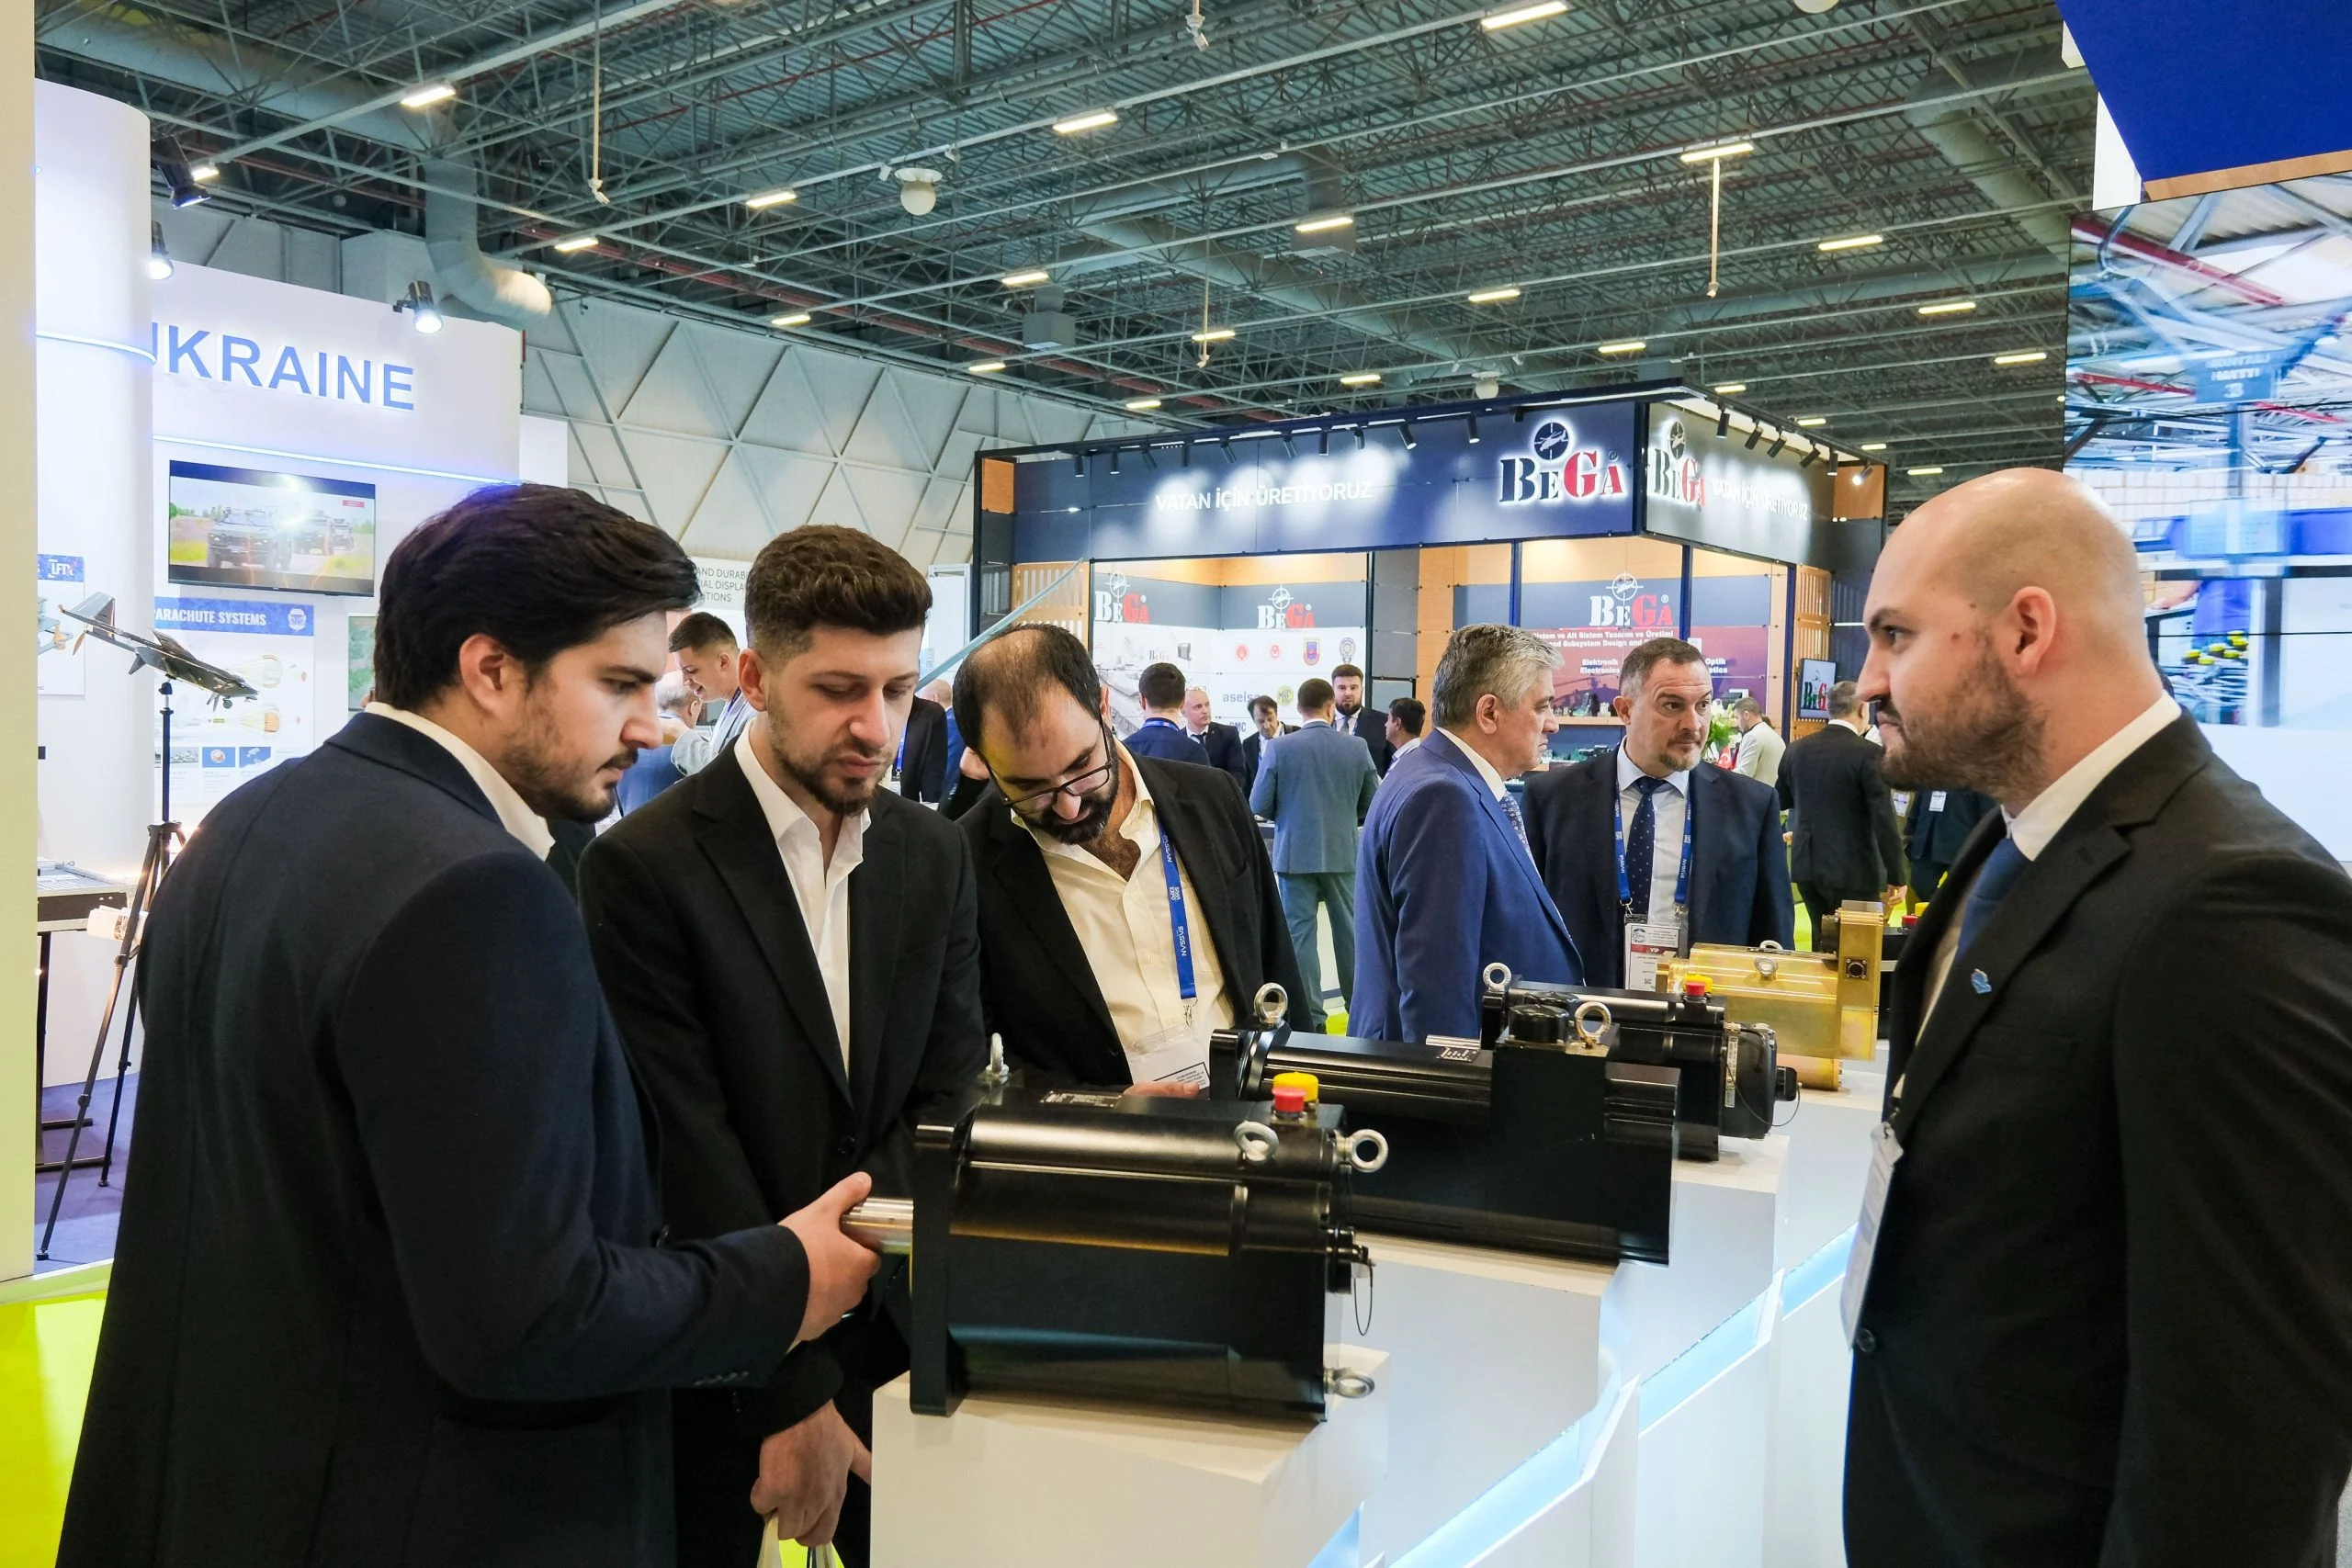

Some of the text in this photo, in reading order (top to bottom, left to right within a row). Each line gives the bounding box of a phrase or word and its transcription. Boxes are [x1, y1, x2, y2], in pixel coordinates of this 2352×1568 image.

[1156, 492, 1210, 511] VATAN
[154, 608, 266, 626] ARACHUTE SYSTEMS
[1582, 658, 1619, 666] Elektronik
[1223, 691, 1262, 703] asels
